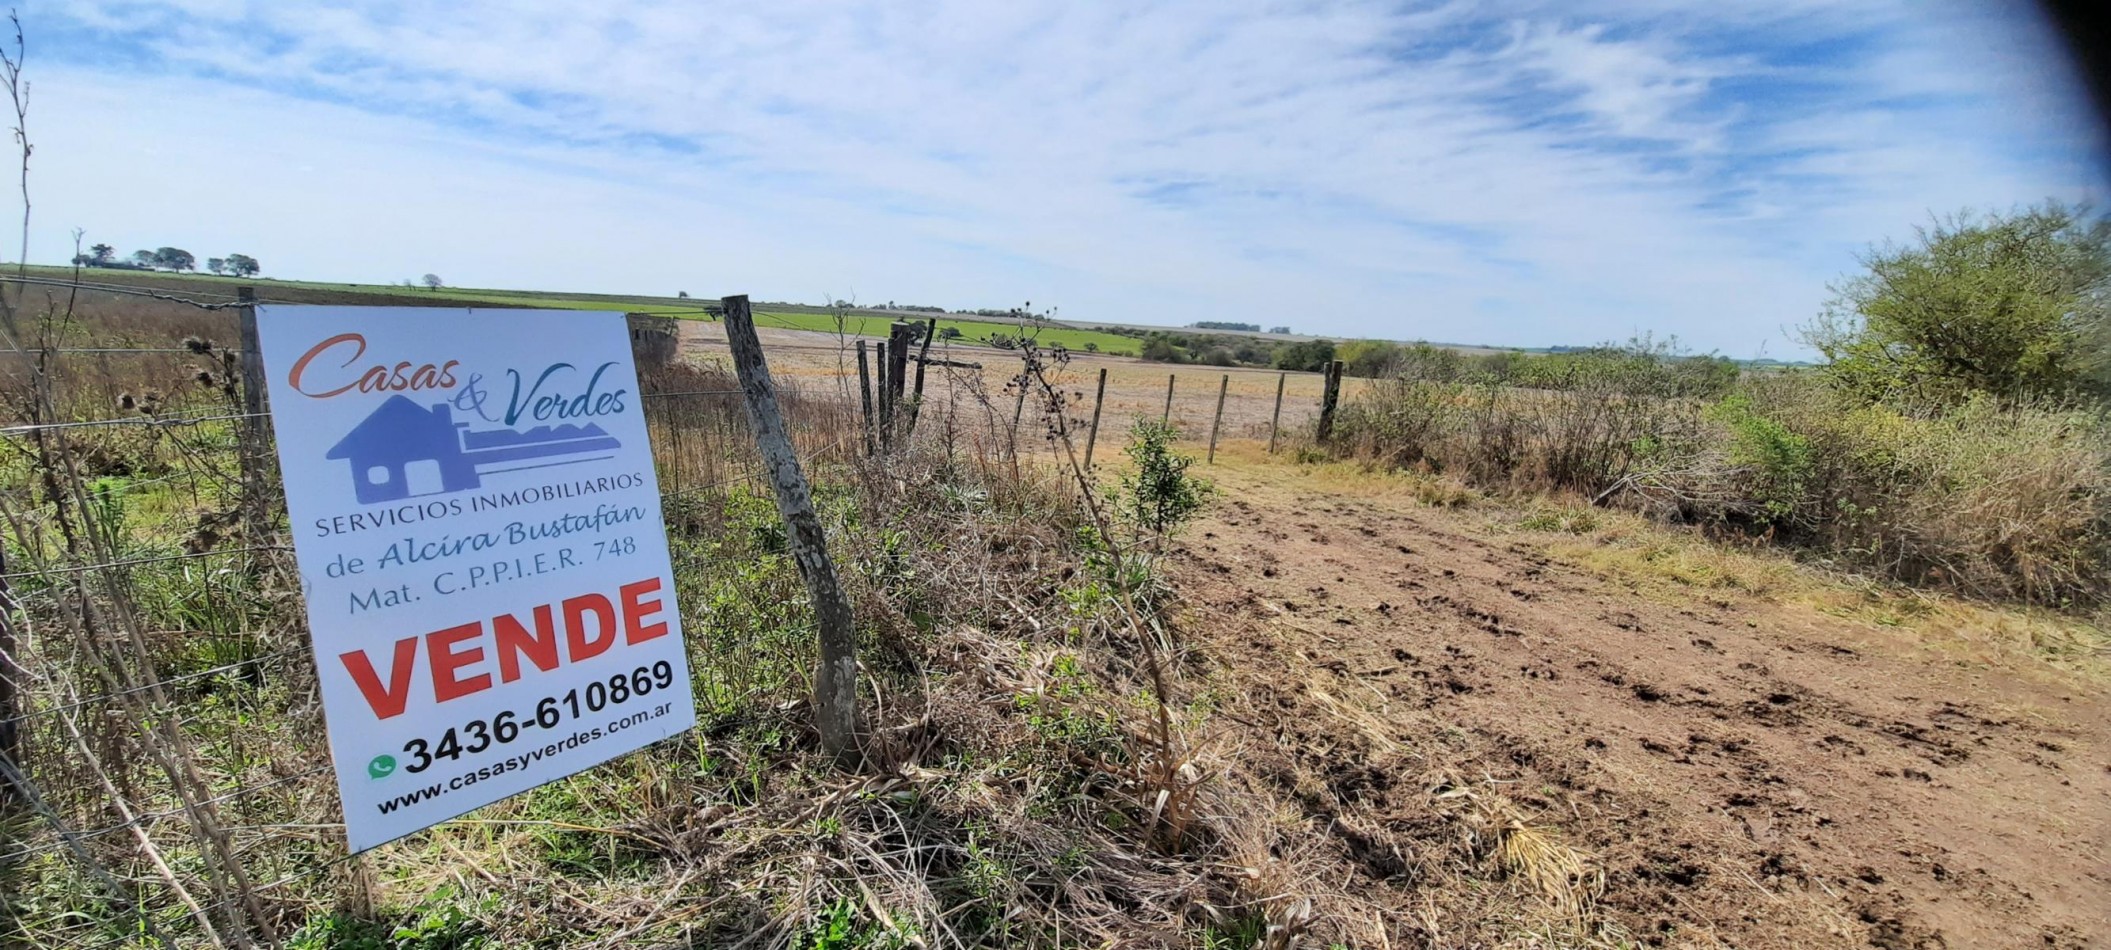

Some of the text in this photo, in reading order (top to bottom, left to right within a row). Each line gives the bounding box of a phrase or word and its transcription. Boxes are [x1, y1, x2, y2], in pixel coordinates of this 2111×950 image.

[288, 332, 627, 426] Casas & Verdes
[315, 471, 644, 537] SERVICIOS INMOBILIARIOS
[325, 503, 647, 579] de Alcira Bustafán
[349, 535, 636, 615] Mat. C.P.P.I.E.R. 748
[338, 576, 669, 721] VENDE
[377, 702, 673, 815] www.casasyverdes.com.ar
[402, 659, 674, 775] 3436-610869
